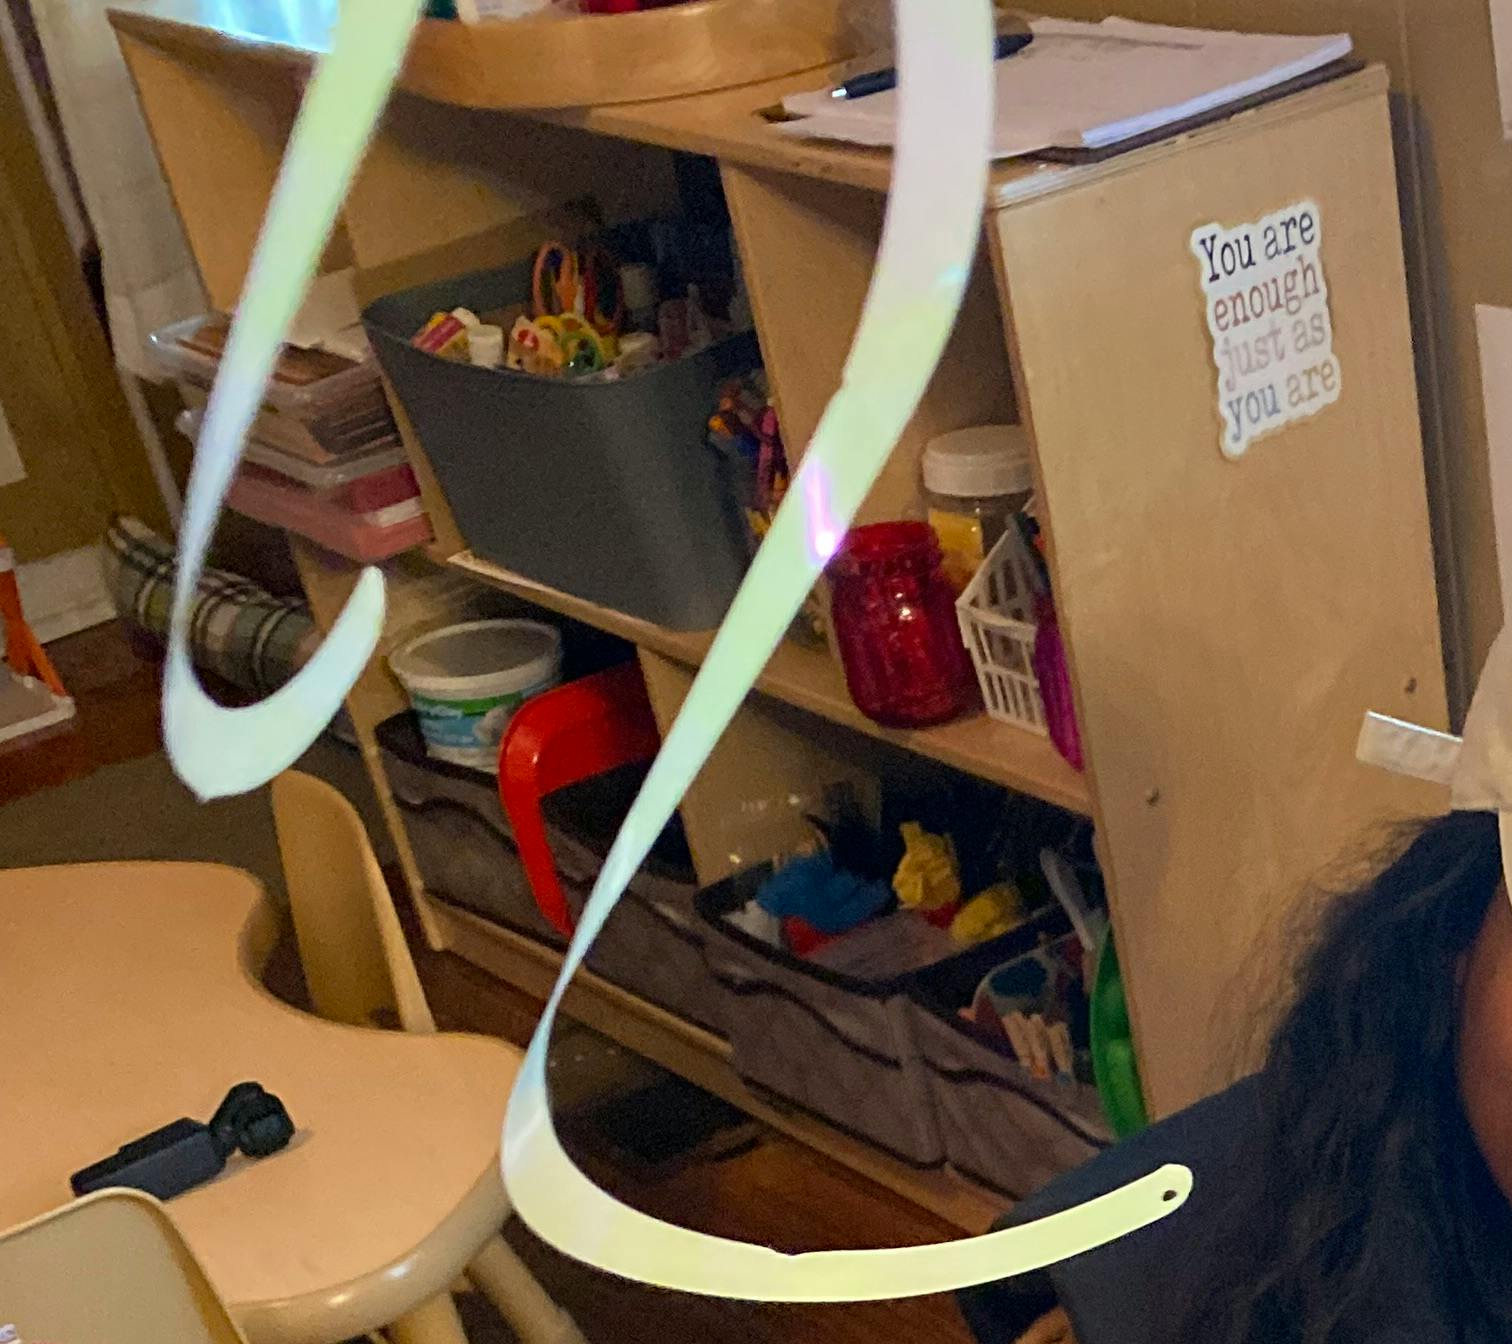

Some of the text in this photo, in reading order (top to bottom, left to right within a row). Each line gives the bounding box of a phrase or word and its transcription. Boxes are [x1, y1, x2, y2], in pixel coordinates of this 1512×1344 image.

[1199, 211, 1315, 283] You are
[1213, 256, 1320, 332] enough
[1221, 312, 1326, 392] just as
[1227, 358, 1337, 443] you are
